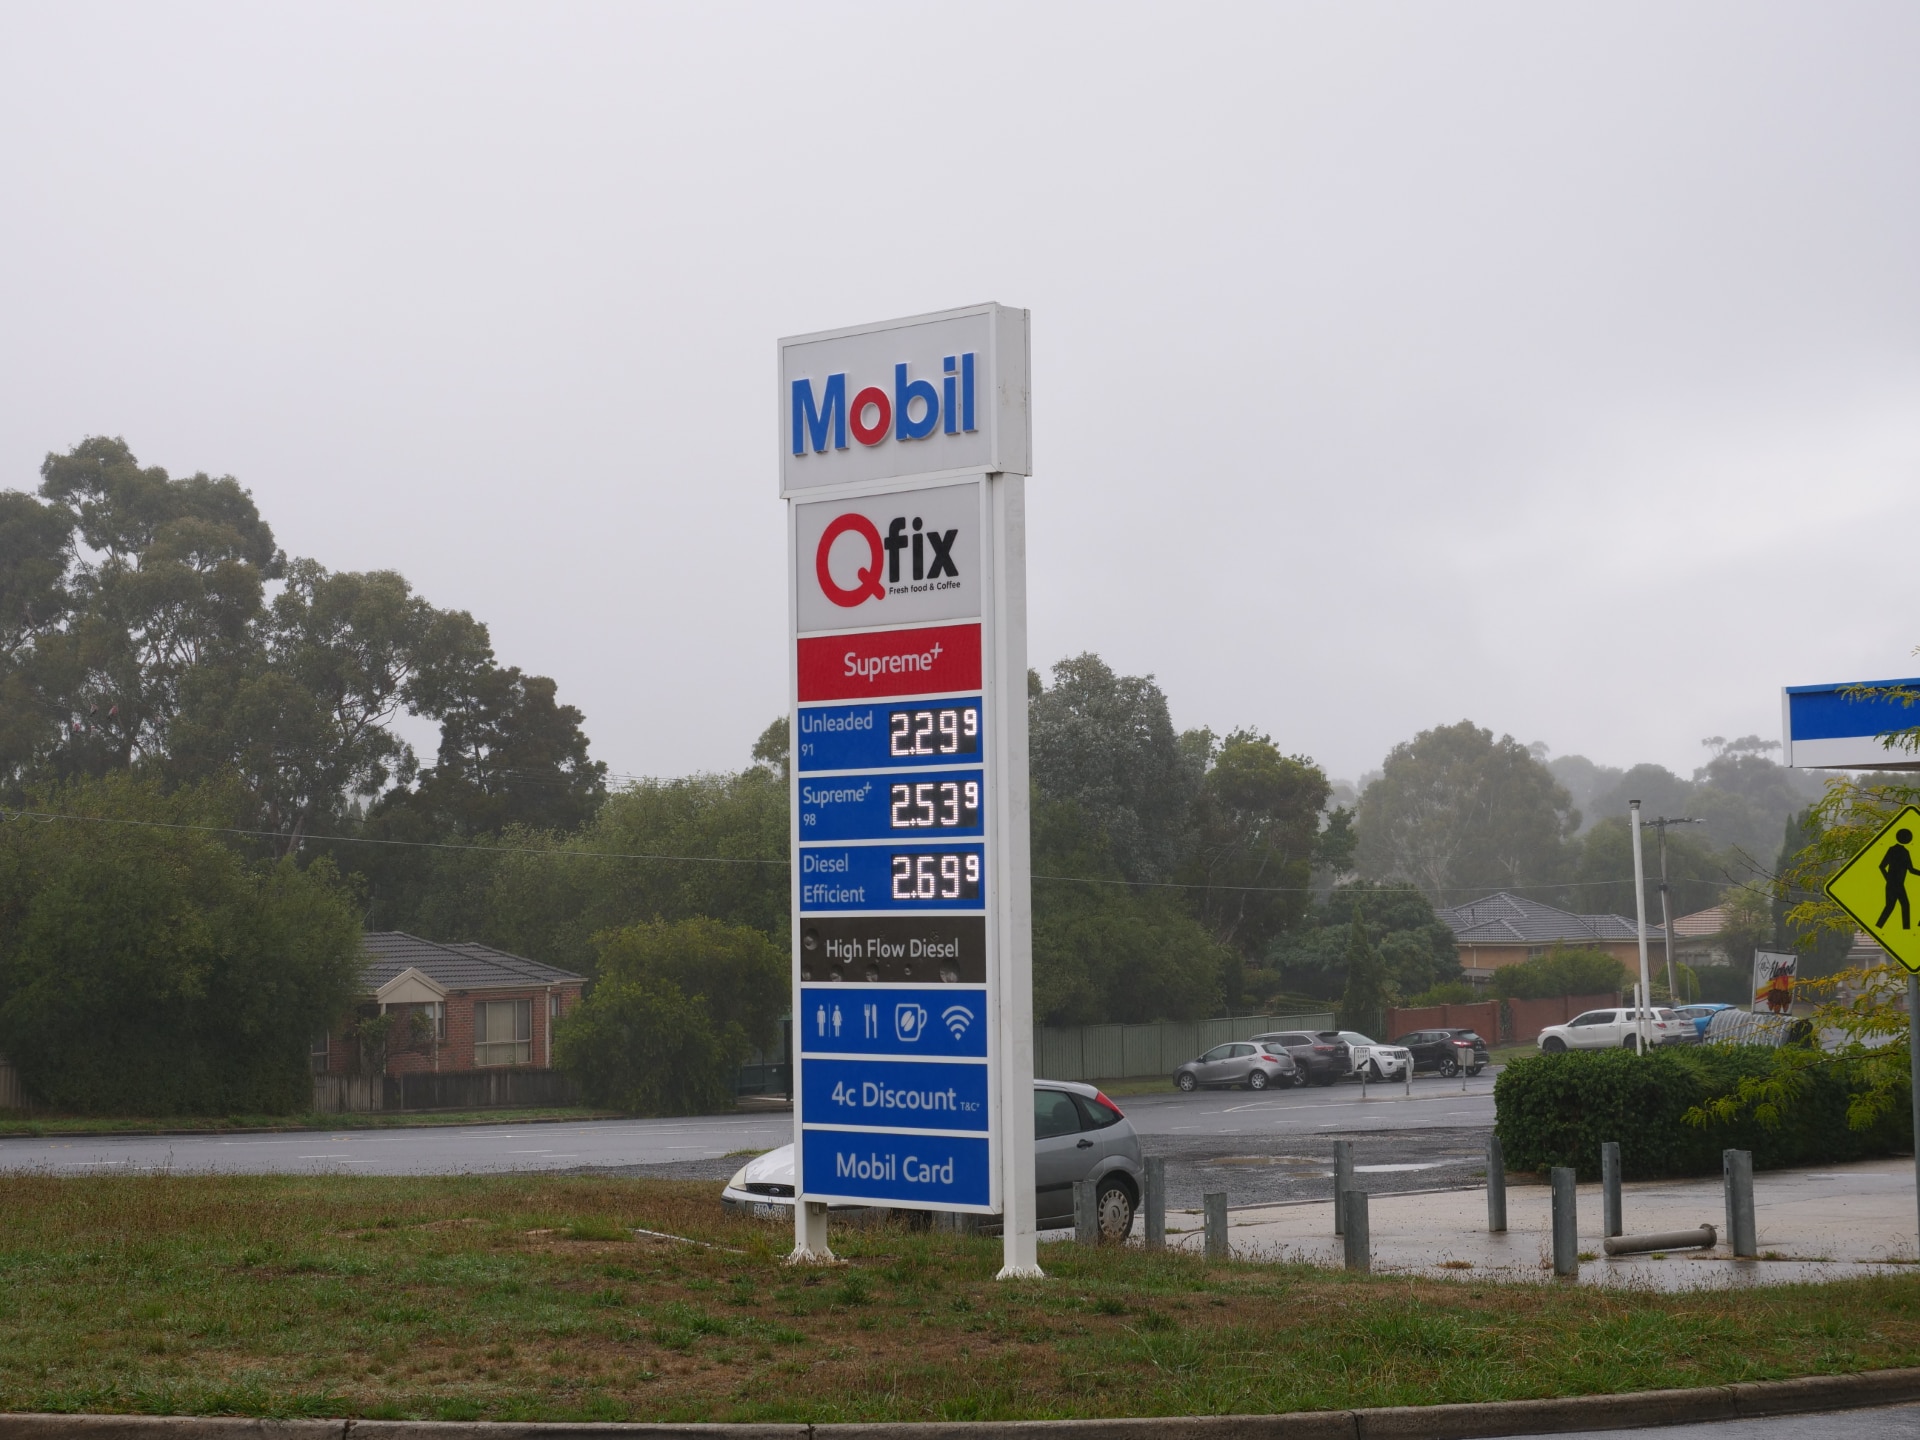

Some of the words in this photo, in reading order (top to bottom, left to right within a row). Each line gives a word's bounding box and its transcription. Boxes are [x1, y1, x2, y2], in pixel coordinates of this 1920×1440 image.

[791, 352, 977, 456] Mobil
[816, 513, 959, 607] Qfix
[889, 586, 909, 595] Fresh
[911, 584, 928, 592] food
[929, 582, 934, 590] &
[936, 581, 961, 590] Coffee
[801, 710, 873, 733] Unleaded
[801, 743, 814, 756] 91
[803, 813, 816, 826] 98
[803, 853, 849, 873] Diesel
[803, 884, 865, 903] Efficient
[826, 938, 862, 964] High
[867, 937, 905, 958] Flow
[910, 937, 959, 958] Diesel
[831, 1081, 856, 1107] 4c
[862, 1082, 957, 1111] Discount
[836, 1152, 896, 1181] Mobil
[902, 1156, 953, 1185] Card
